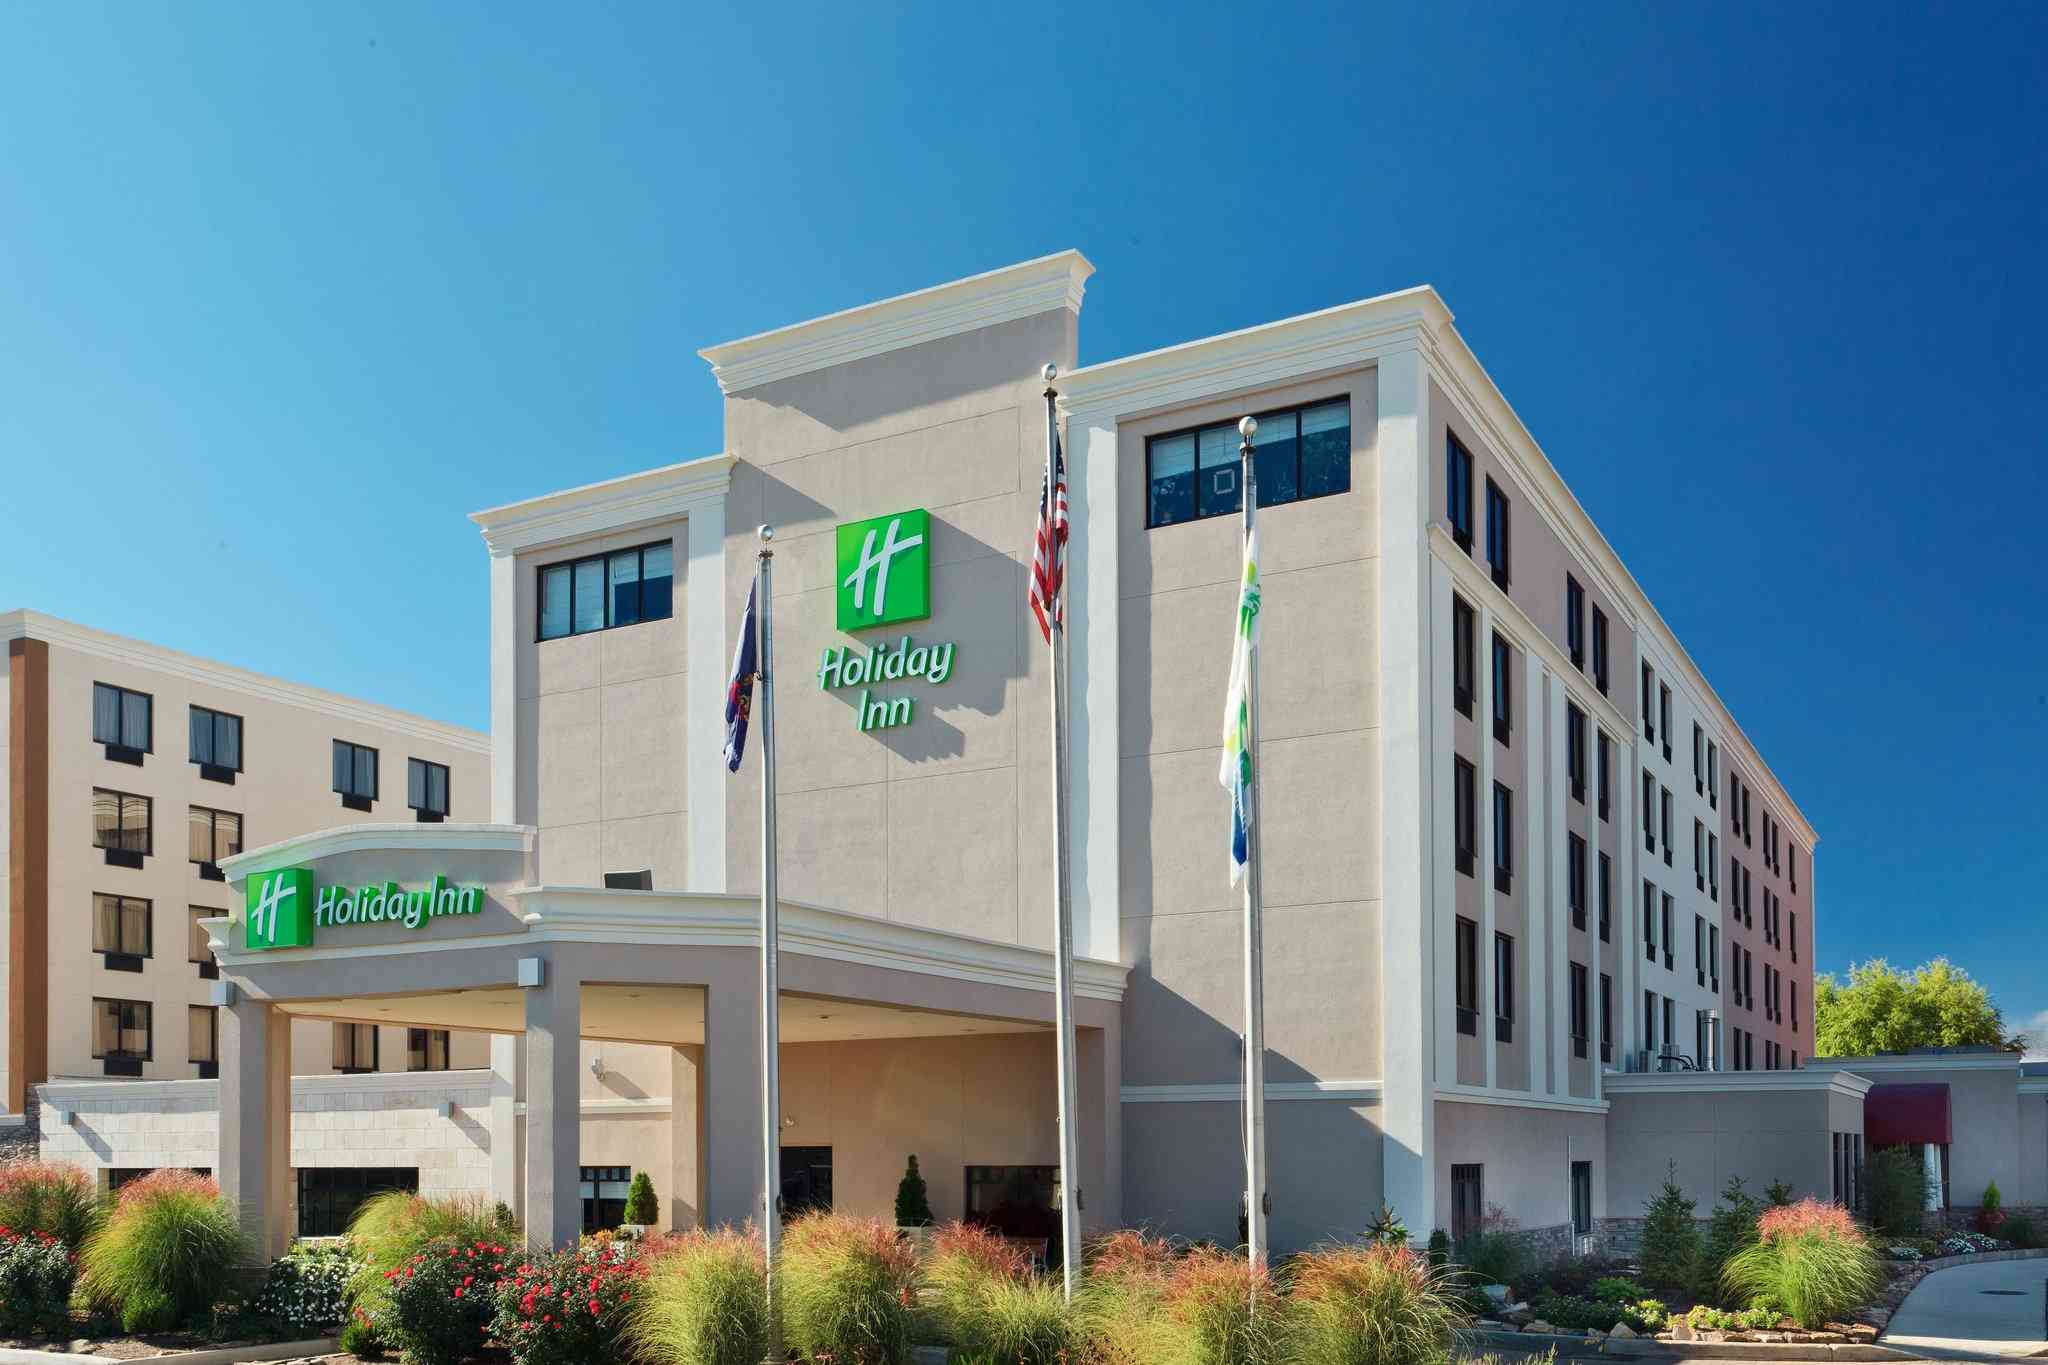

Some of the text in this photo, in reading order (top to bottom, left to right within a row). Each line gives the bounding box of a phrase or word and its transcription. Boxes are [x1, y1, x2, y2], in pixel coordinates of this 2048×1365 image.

[844, 519, 923, 616] H
[818, 635, 955, 689] Holiday
[858, 690, 913, 732] Inn
[252, 873, 296, 943] H
[313, 873, 482, 929] Holiday Inn
